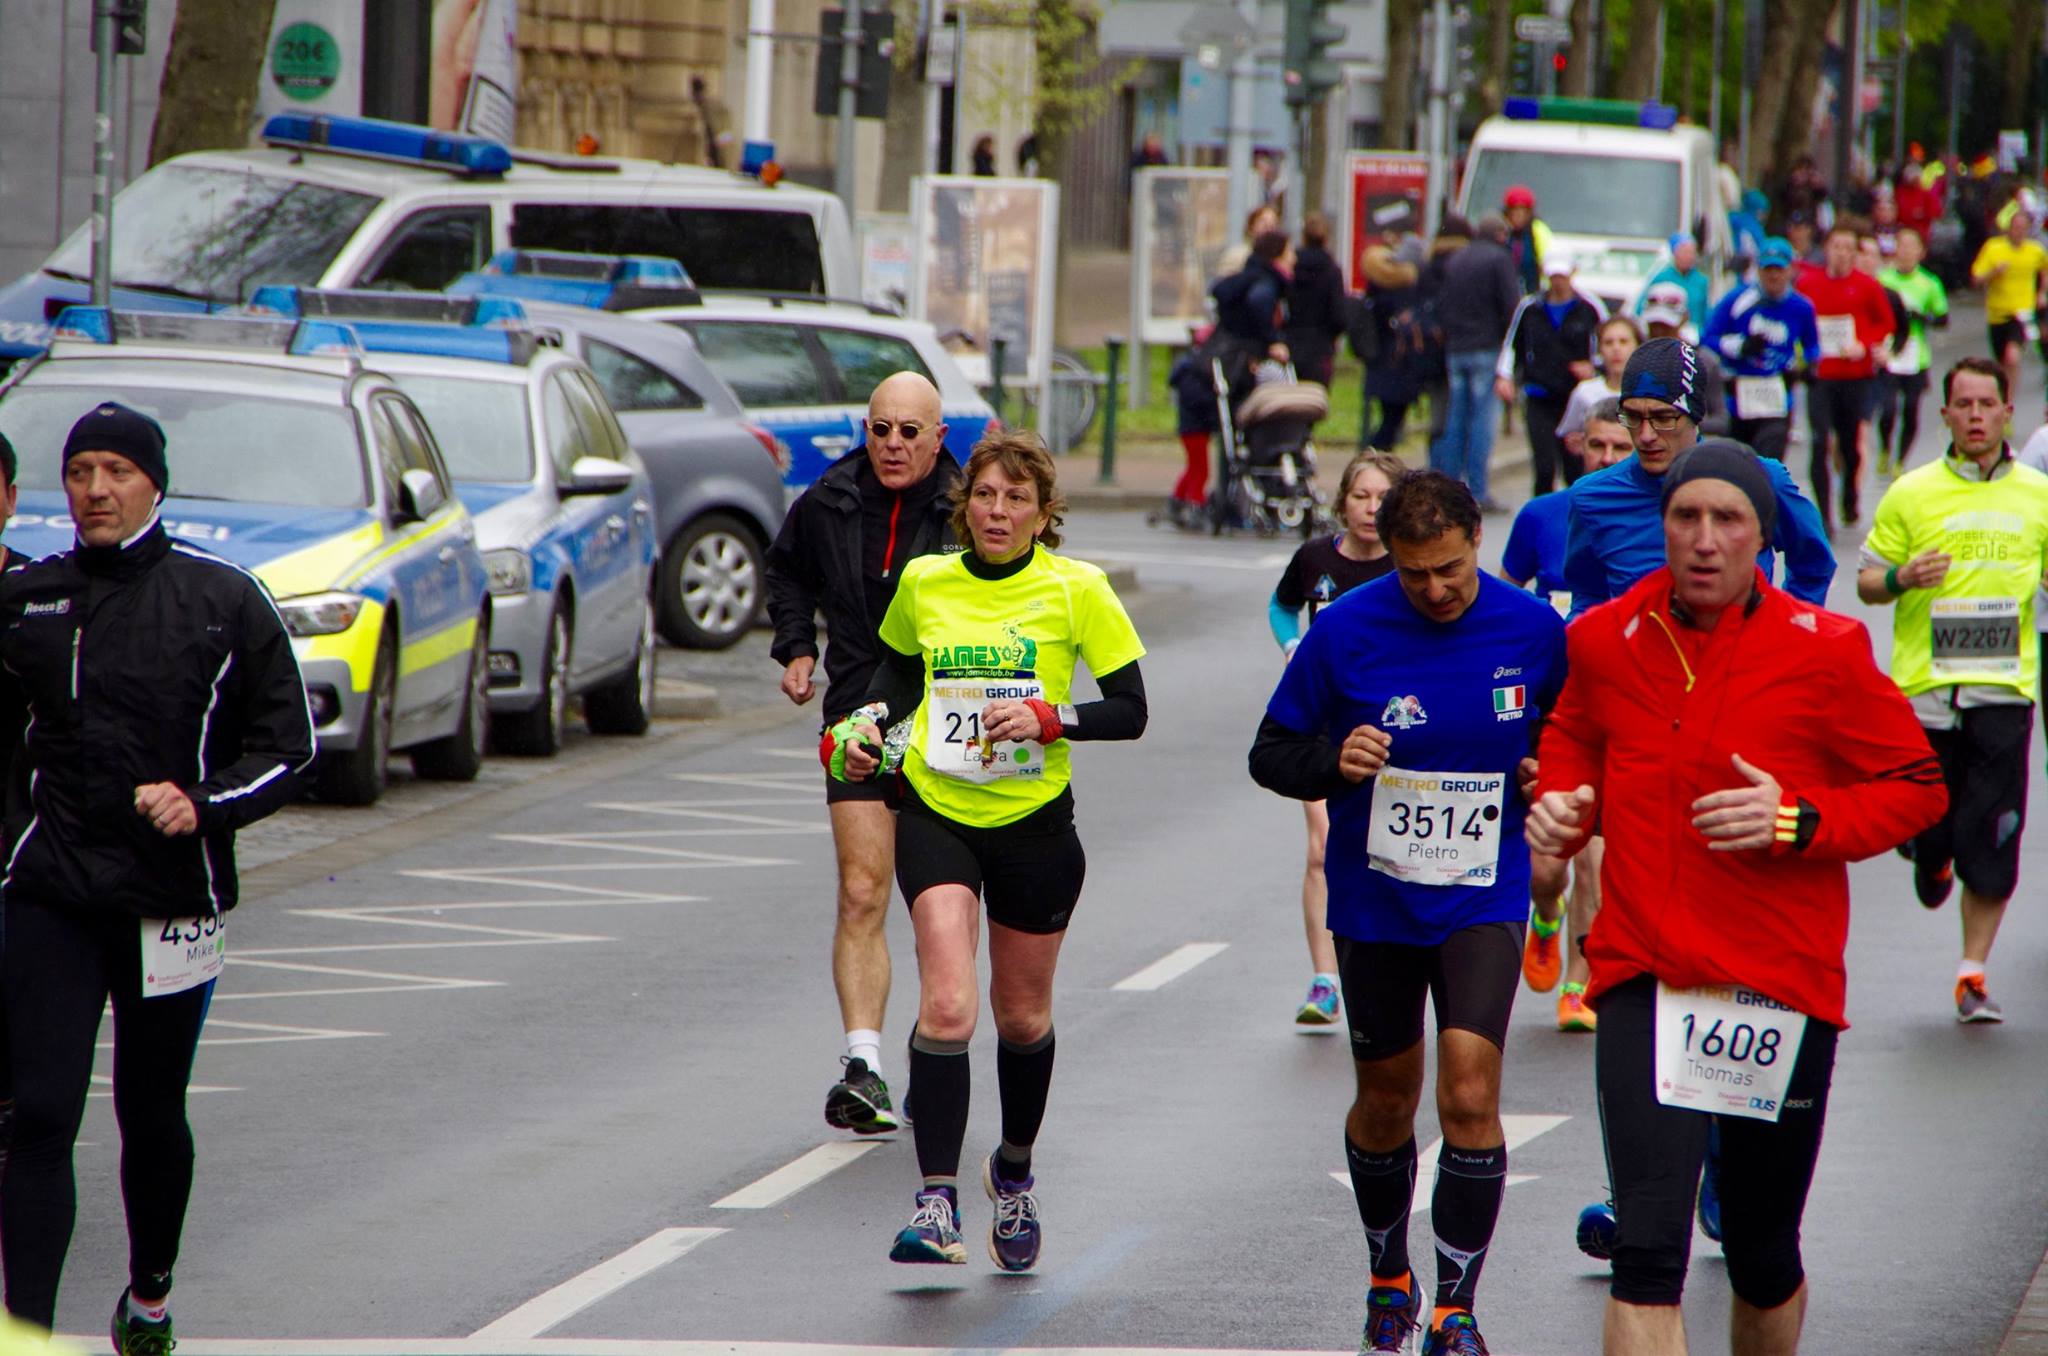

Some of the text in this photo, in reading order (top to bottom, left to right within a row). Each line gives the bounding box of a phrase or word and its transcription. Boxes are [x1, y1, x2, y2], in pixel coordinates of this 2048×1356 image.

[1961, 541, 2008, 561] 2016
[934, 686, 1040, 699] METRO GROUP
[1497, 710, 1523, 722] PIETRO
[1380, 774, 1500, 792] METRO GROUP
[1388, 802, 1483, 841] 3514
[1408, 843, 1459, 859] Pietro
[186, 944, 214, 963] Mike
[1682, 1013, 1781, 1067] 1608
[1687, 1058, 1754, 1087] Thomas
[1749, 1097, 1776, 1112] DUS
